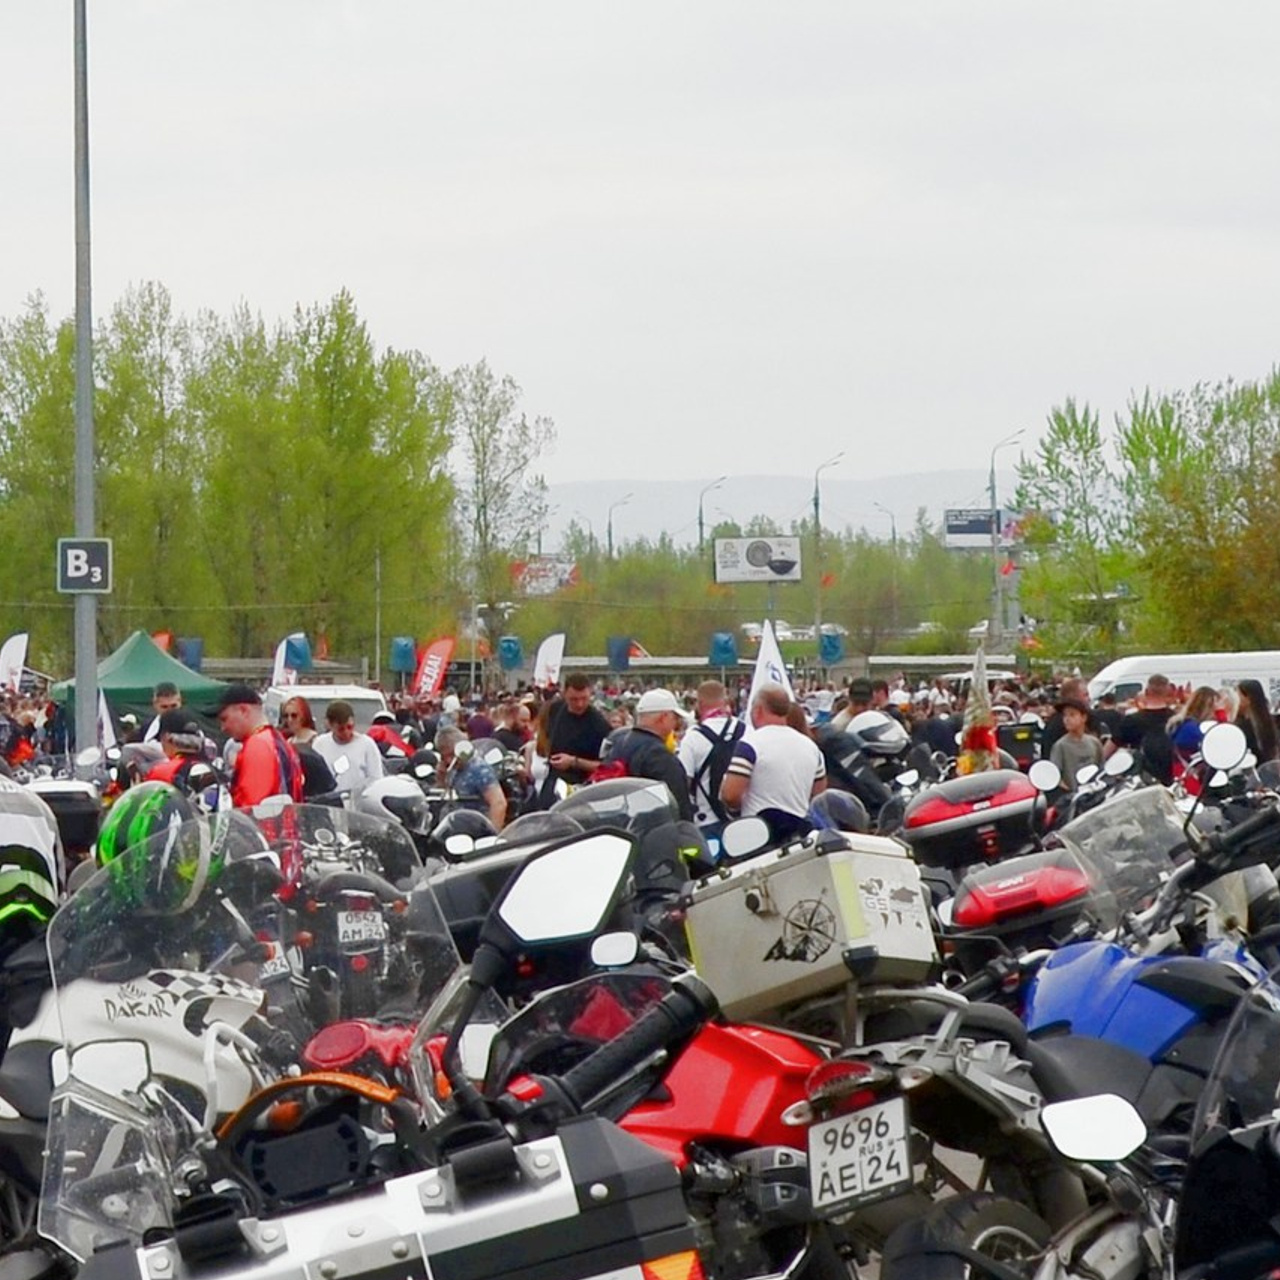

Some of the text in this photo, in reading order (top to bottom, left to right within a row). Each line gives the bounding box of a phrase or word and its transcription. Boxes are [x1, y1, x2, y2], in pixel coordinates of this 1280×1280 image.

[103, 993, 172, 1022] DAKAR
[823, 1111, 890, 1156] 9696
[859, 1140, 884, 1157] RUS
[818, 1149, 902, 1201] AE 24
